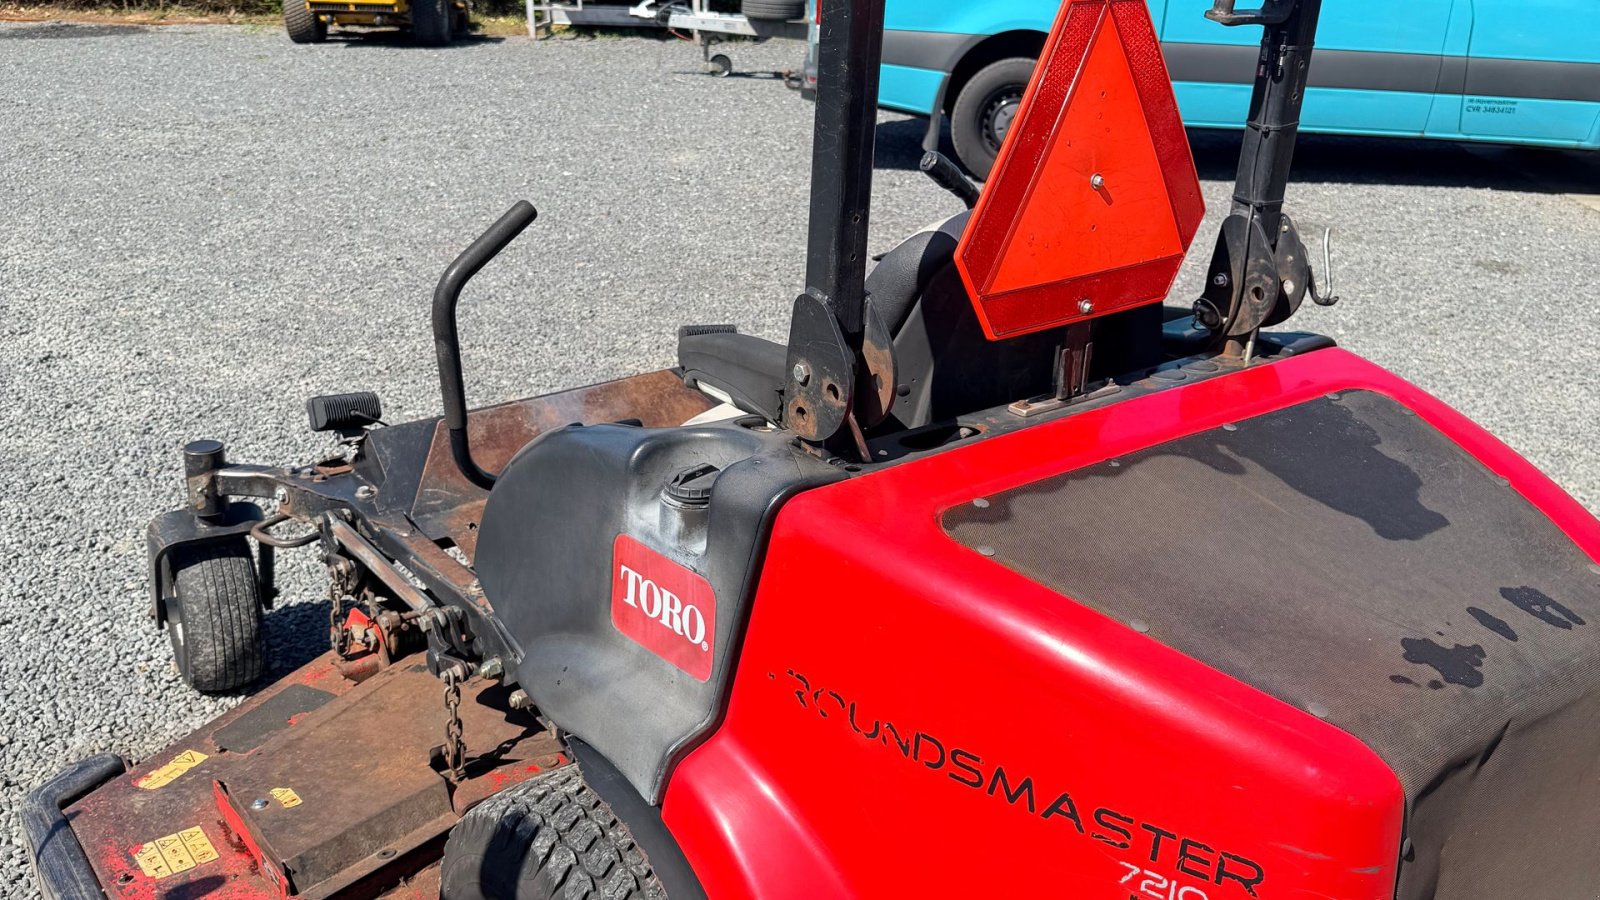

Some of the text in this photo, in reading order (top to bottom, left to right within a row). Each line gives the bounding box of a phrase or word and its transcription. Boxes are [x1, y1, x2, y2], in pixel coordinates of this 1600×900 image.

[1466, 105, 1481, 113] CVR
[620, 564, 706, 645] TORO
[767, 668, 1265, 898] ROUNDSMASTER
